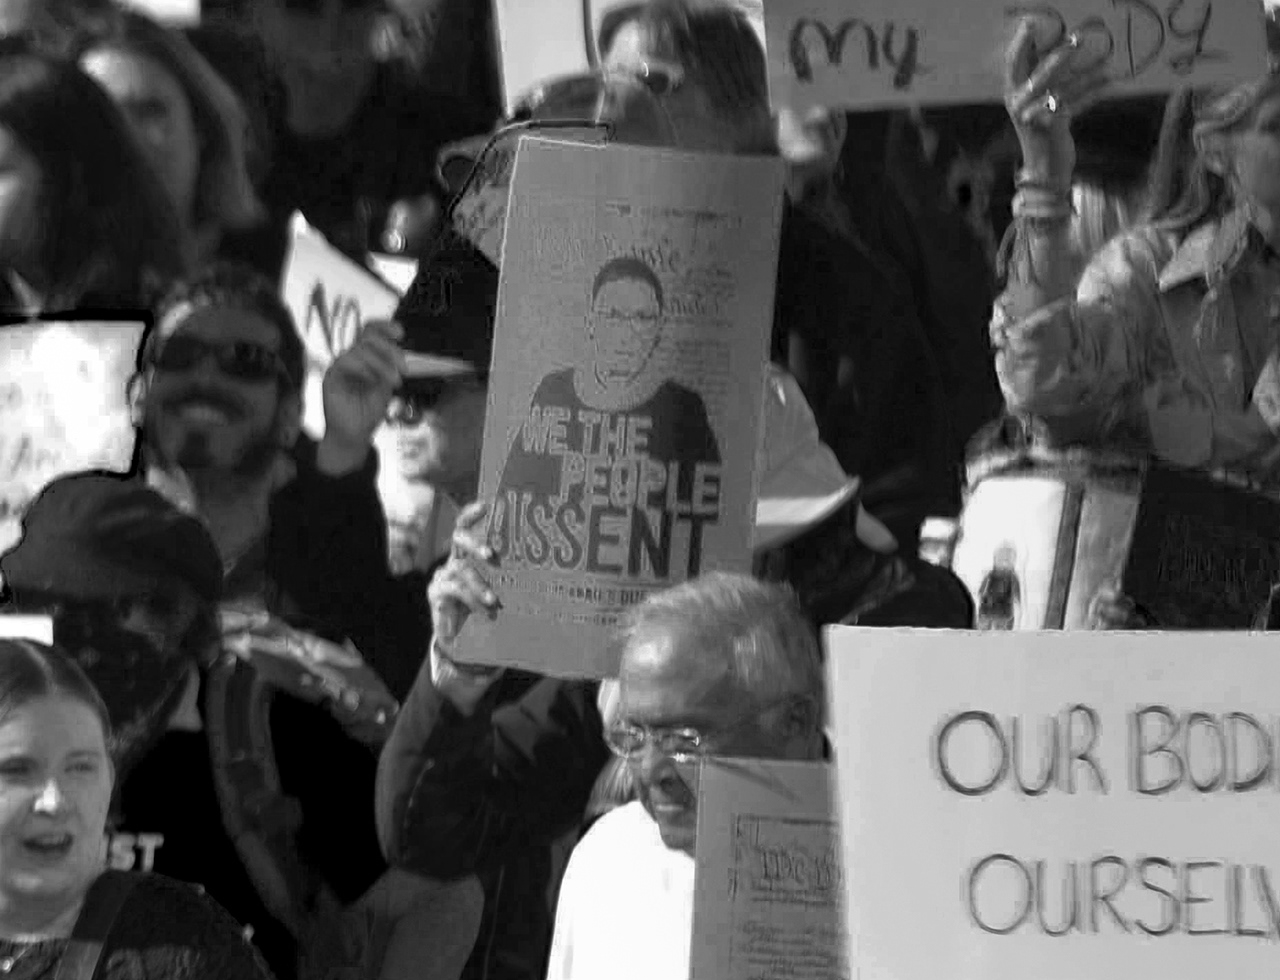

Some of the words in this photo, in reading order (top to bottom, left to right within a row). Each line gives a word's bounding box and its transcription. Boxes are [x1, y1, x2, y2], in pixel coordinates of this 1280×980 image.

[576, 408, 653, 463] THE
[558, 452, 722, 515] PEOPLE
[938, 703, 1110, 797] OUR
[1134, 703, 1280, 797] BOD
